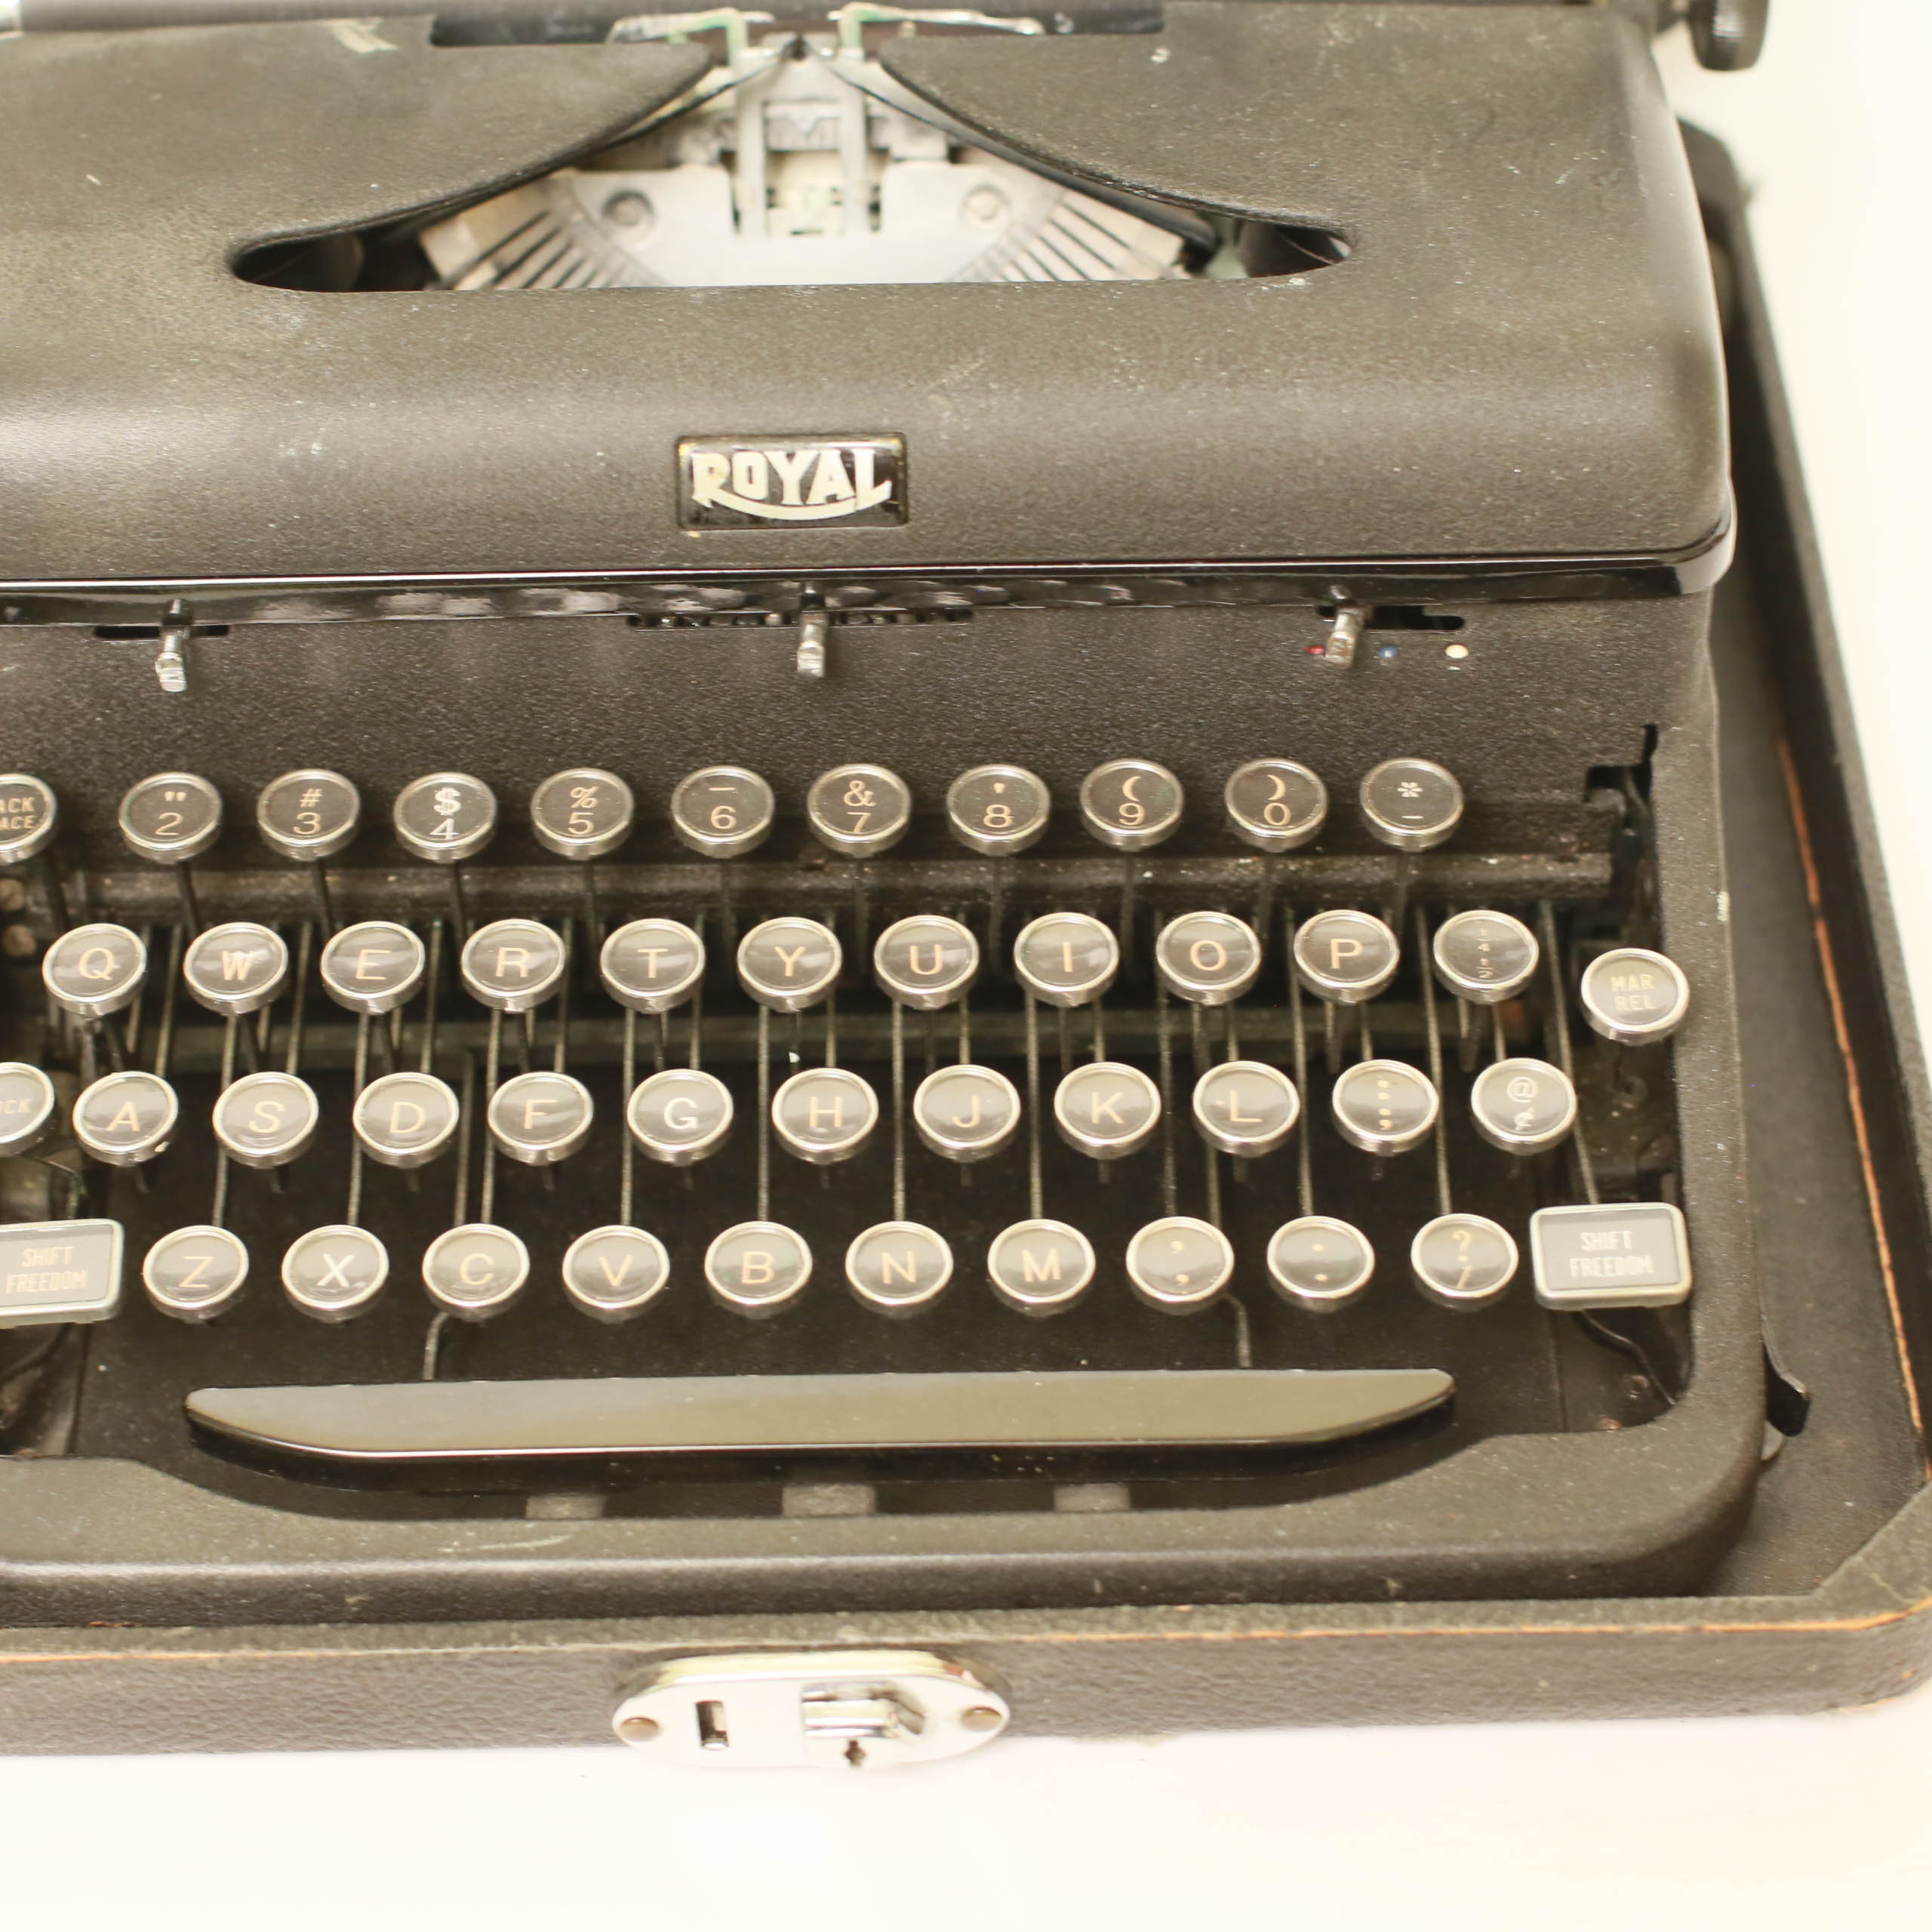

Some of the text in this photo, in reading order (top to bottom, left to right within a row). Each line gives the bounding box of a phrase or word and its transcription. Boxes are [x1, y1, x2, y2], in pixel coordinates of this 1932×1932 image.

[691, 448, 892, 520] ROYAL
[298, 789, 323, 808] #
[434, 788, 462, 817] $
[570, 786, 598, 809] %
[844, 781, 877, 808] &
[155, 813, 180, 836] 2
[293, 813, 321, 835] 3
[429, 819, 460, 840] 4
[568, 812, 595, 835] 5
[710, 806, 737, 829] 6
[846, 811, 872, 834] 7
[983, 804, 1014, 828] 8
[1118, 803, 1146, 826] 9
[78, 948, 114, 980] Q
[222, 950, 257, 980] W
[355, 949, 388, 980] E
[495, 947, 531, 978] R
[638, 948, 669, 978] T
[774, 946, 806, 977] Y
[908, 944, 942, 975] U
[1063, 941, 1073, 972] I
[1189, 940, 1227, 971] O
[1330, 939, 1360, 969] P
[1611, 974, 1654, 992] MAR
[1614, 994, 1657, 1012] REL
[1506, 1076, 1539, 1103] @
[106, 1100, 141, 1132] A
[248, 1100, 285, 1133] S
[389, 1101, 426, 1134] D
[523, 1099, 557, 1130] F
[663, 1097, 699, 1129] G
[808, 1096, 843, 1128] H
[951, 1095, 981, 1128] J
[1091, 1091, 1124, 1124] K
[1229, 1090, 1263, 1122] L
[1451, 1230, 1472, 1262] ?
[1580, 1230, 1633, 1251] SHIFT
[21, 1246, 74, 1268] SHIFT
[179, 1255, 214, 1288] Z
[315, 1253, 355, 1287] X
[459, 1253, 494, 1286] C
[598, 1254, 634, 1287] V
[741, 1251, 775, 1284] B
[881, 1250, 916, 1284] N
[1021, 1247, 1061, 1282] M
[1569, 1254, 1655, 1277] FREEDOM
[5, 1269, 89, 1294] FREEDOM
